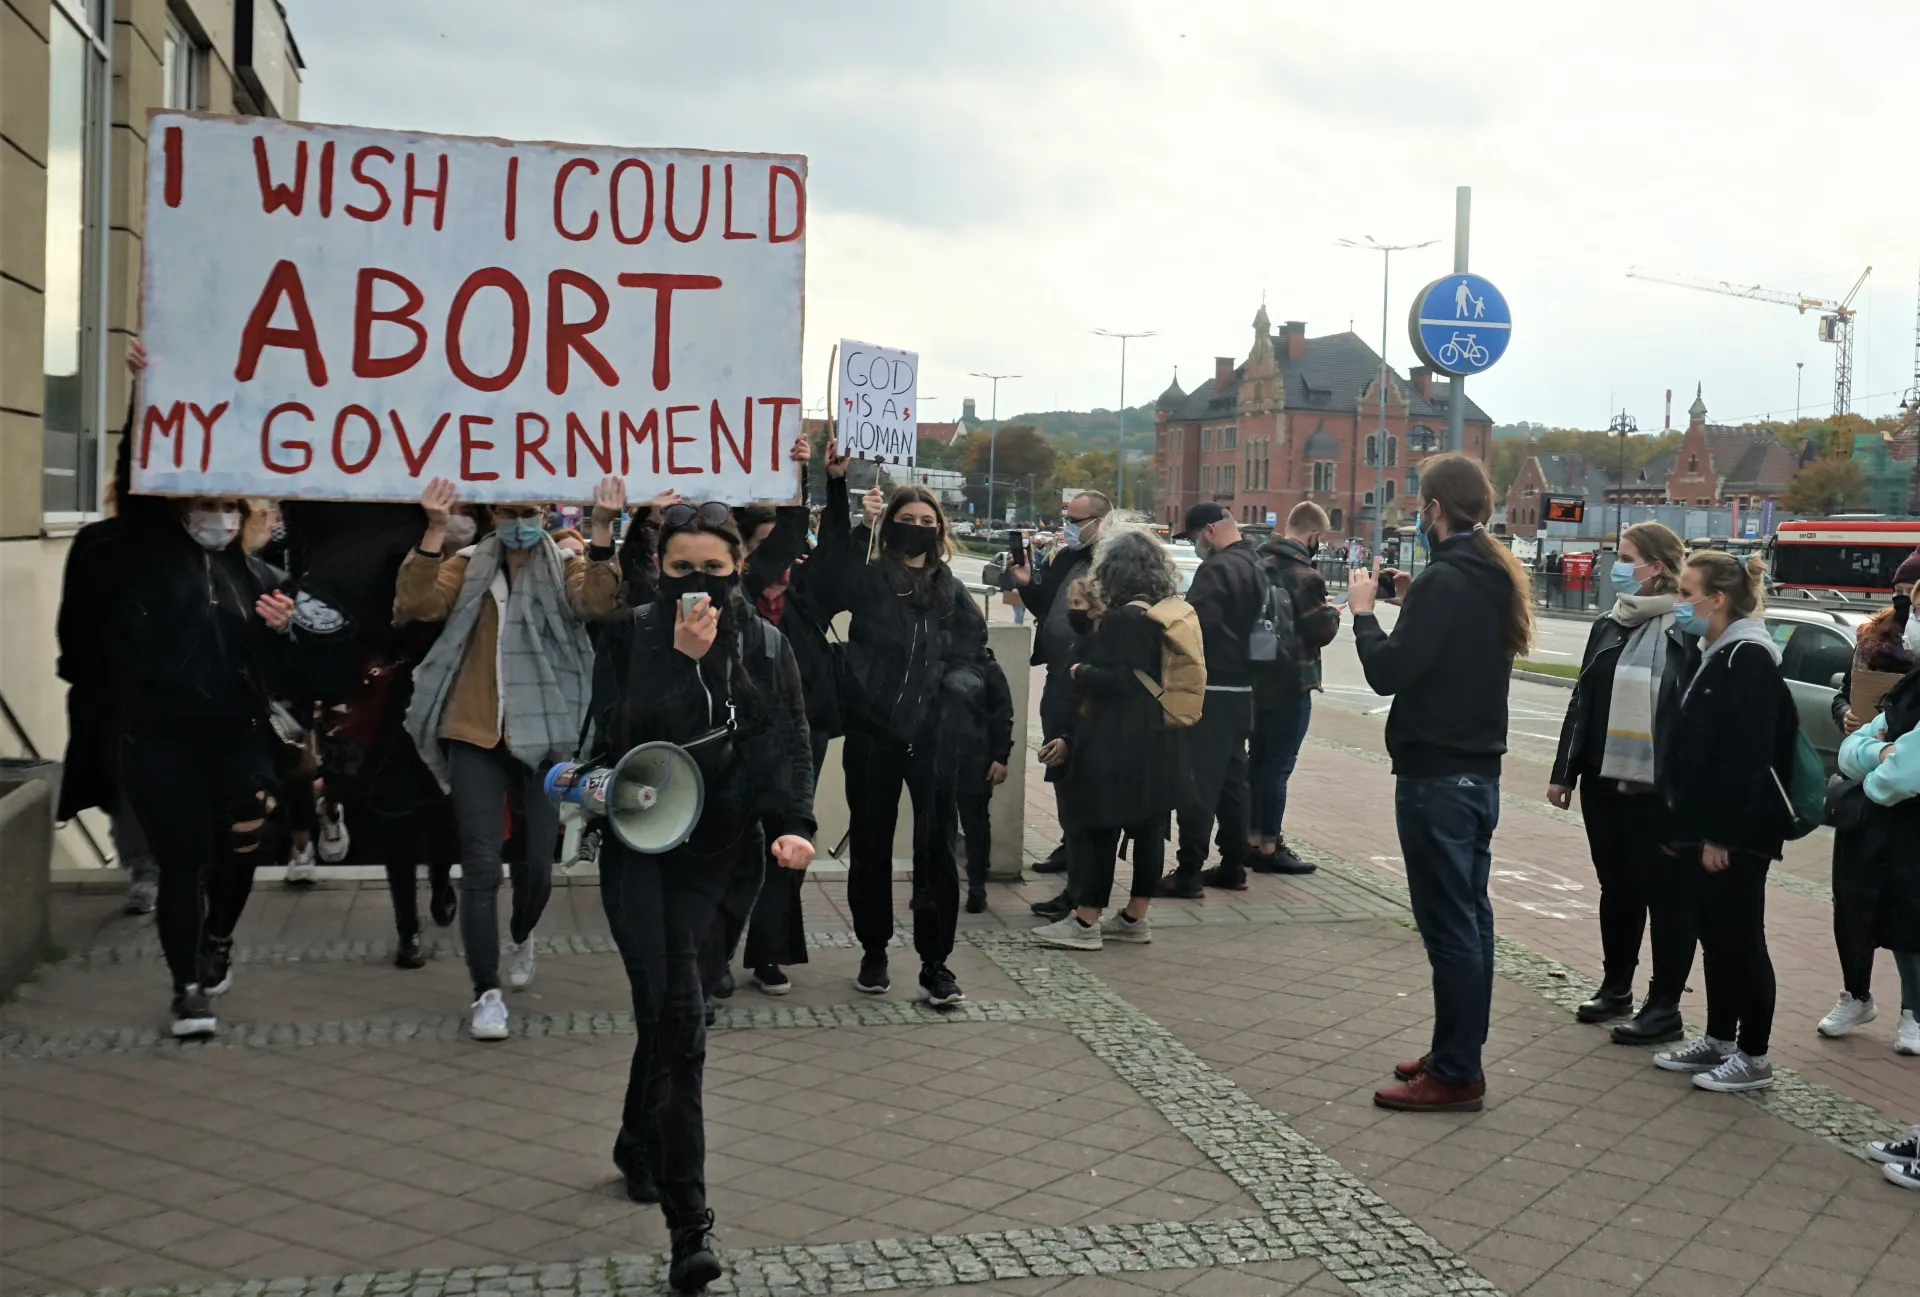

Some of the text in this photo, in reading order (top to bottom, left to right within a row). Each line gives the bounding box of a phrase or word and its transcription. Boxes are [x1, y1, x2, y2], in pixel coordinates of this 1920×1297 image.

[164, 126, 804, 245] I WISH I COULD
[234, 260, 723, 396] ABORT
[846, 351, 914, 395] GOD
[140, 396, 801, 482] MY GOVERNMENT
[845, 416, 914, 455] WOMAN
[855, 392, 898, 421] IS A
